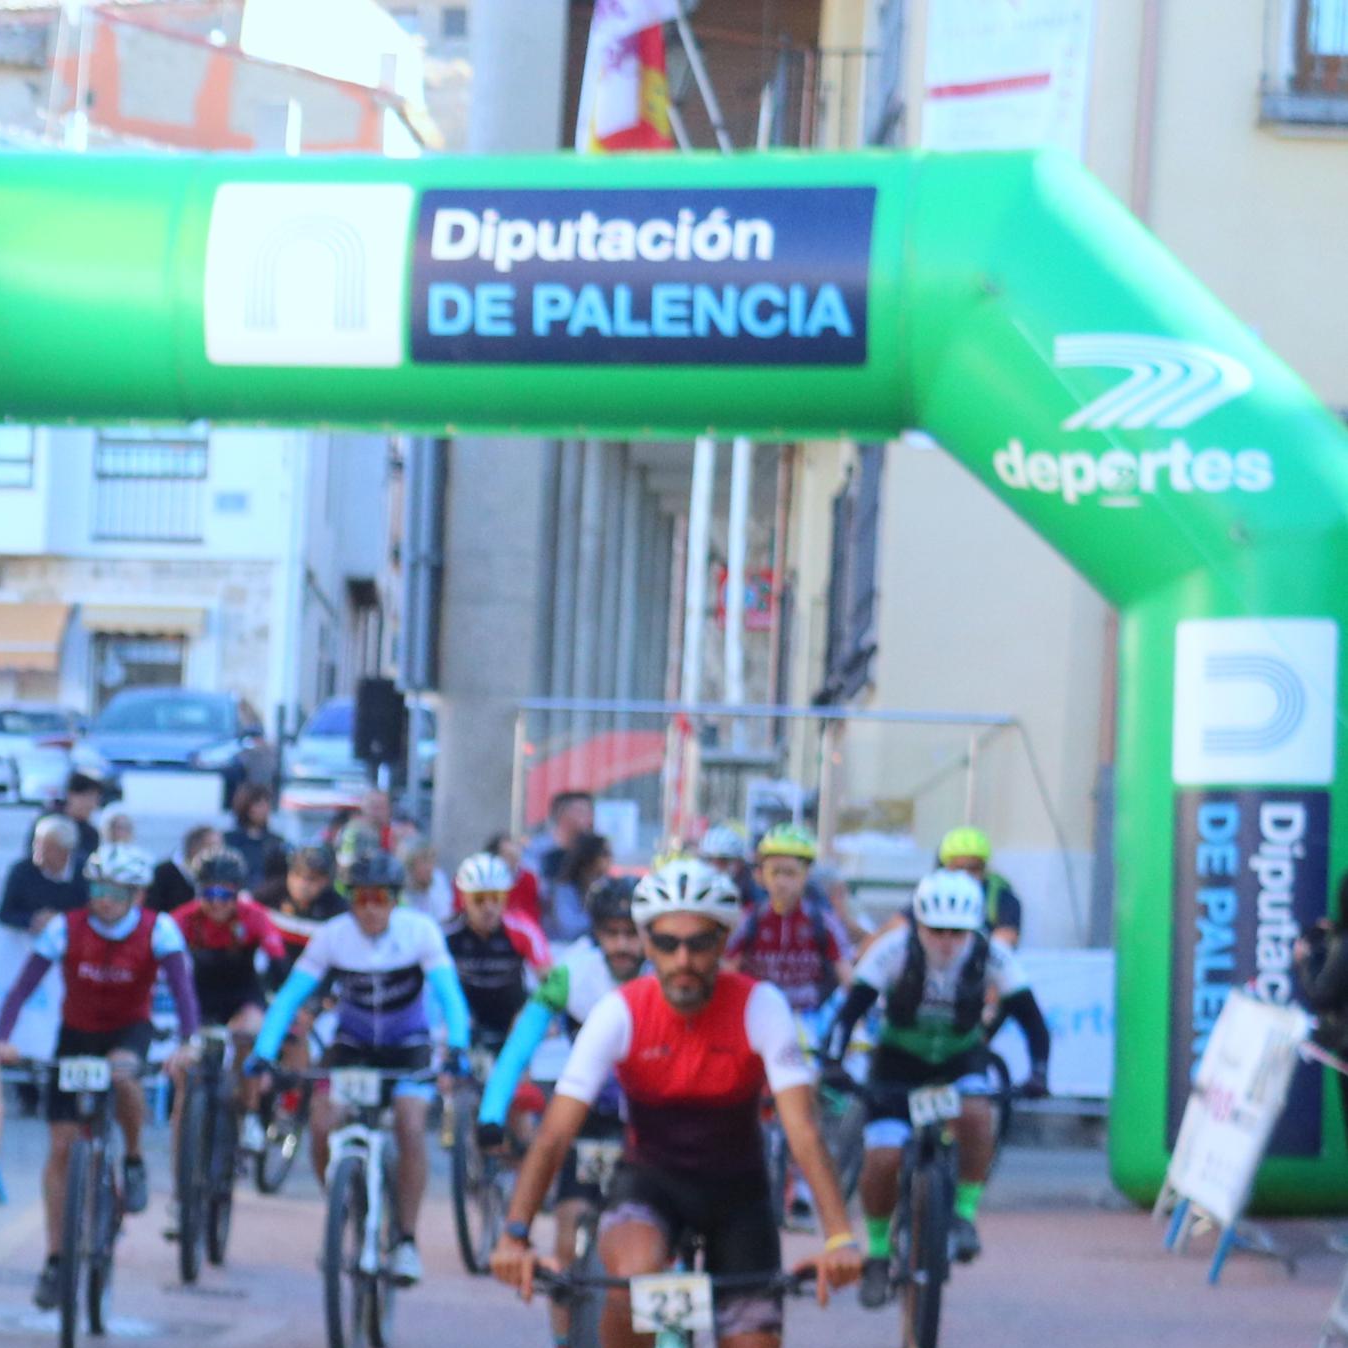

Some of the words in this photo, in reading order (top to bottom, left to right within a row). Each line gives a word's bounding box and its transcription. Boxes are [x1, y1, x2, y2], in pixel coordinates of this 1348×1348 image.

[430, 206, 775, 273] Diputación
[427, 281, 518, 338] DE
[531, 281, 856, 339] PALENCIA
[992, 437, 1276, 506] deportes
[1195, 801, 1241, 878] DE
